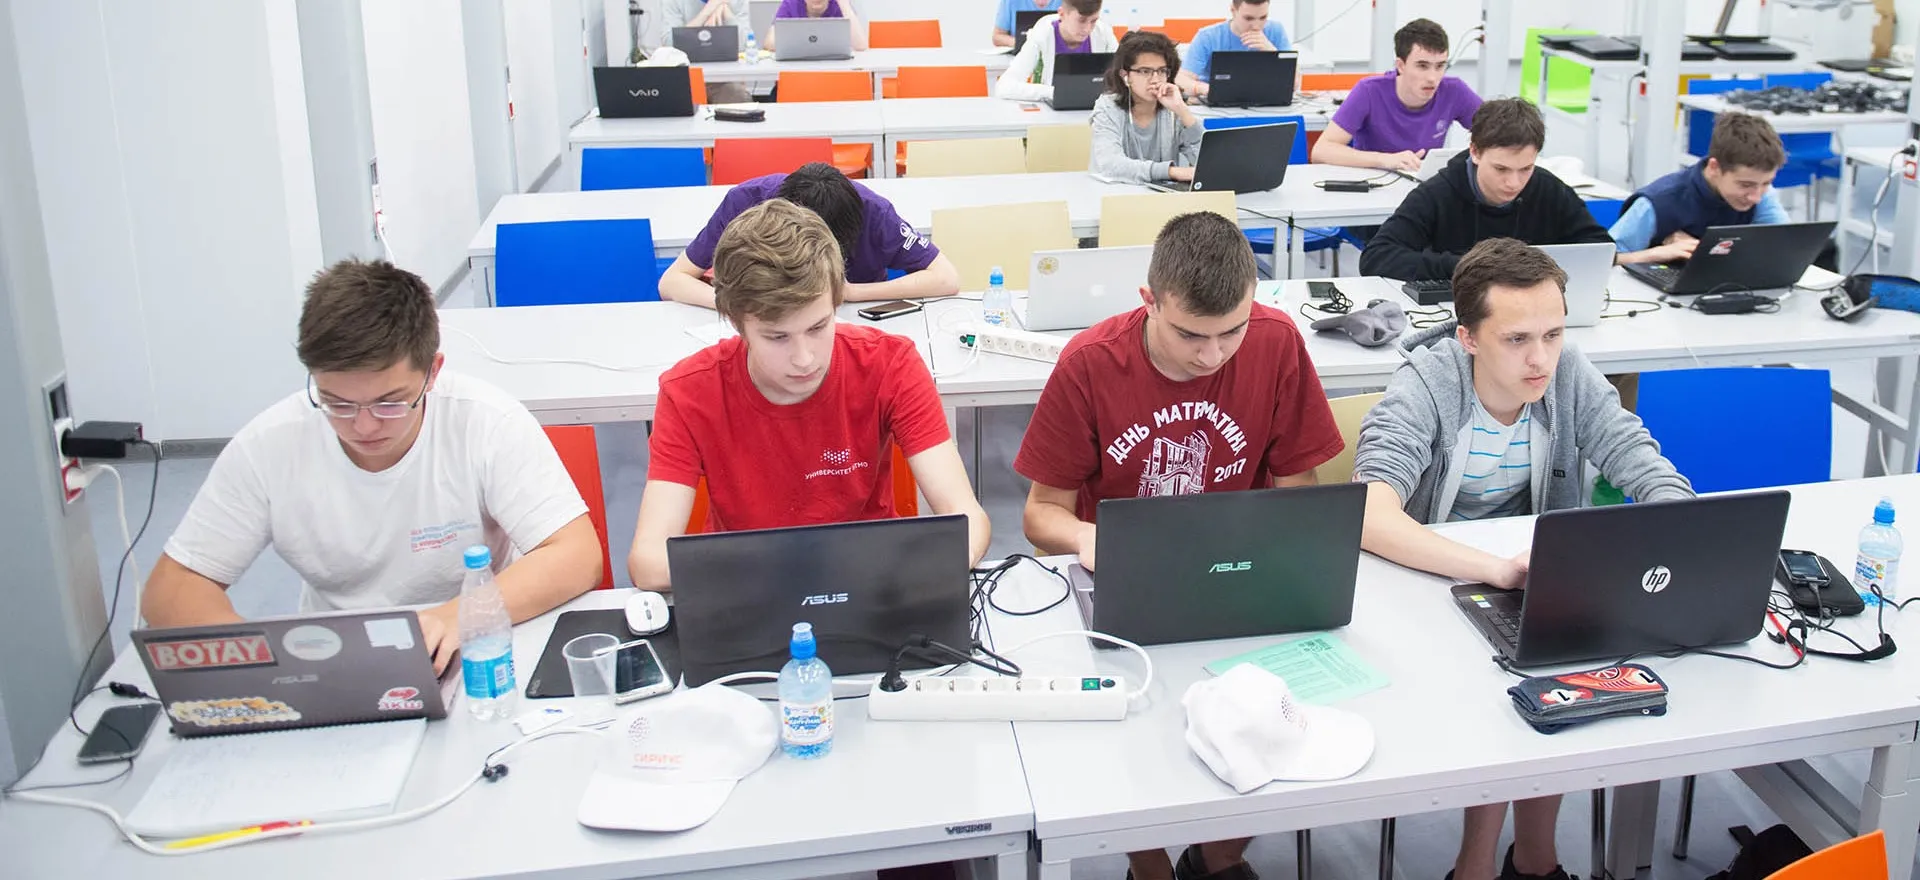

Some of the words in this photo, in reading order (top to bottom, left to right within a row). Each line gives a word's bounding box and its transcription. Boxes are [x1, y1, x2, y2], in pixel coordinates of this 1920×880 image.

[628, 89, 660, 97] VAIO
[1106, 423, 1150, 465] ДЕНЬ
[804, 467, 852, 480] УНИВЕРСИТЕТ
[1214, 458, 1247, 483] 2017
[1208, 561, 1252, 573] ASUS
[1643, 566, 1670, 593] hp
[801, 592, 849, 606] ASUS
[155, 637, 261, 667] BOTAY
[272, 674, 318, 684] ASUS
[945, 822, 992, 835] VIKING
